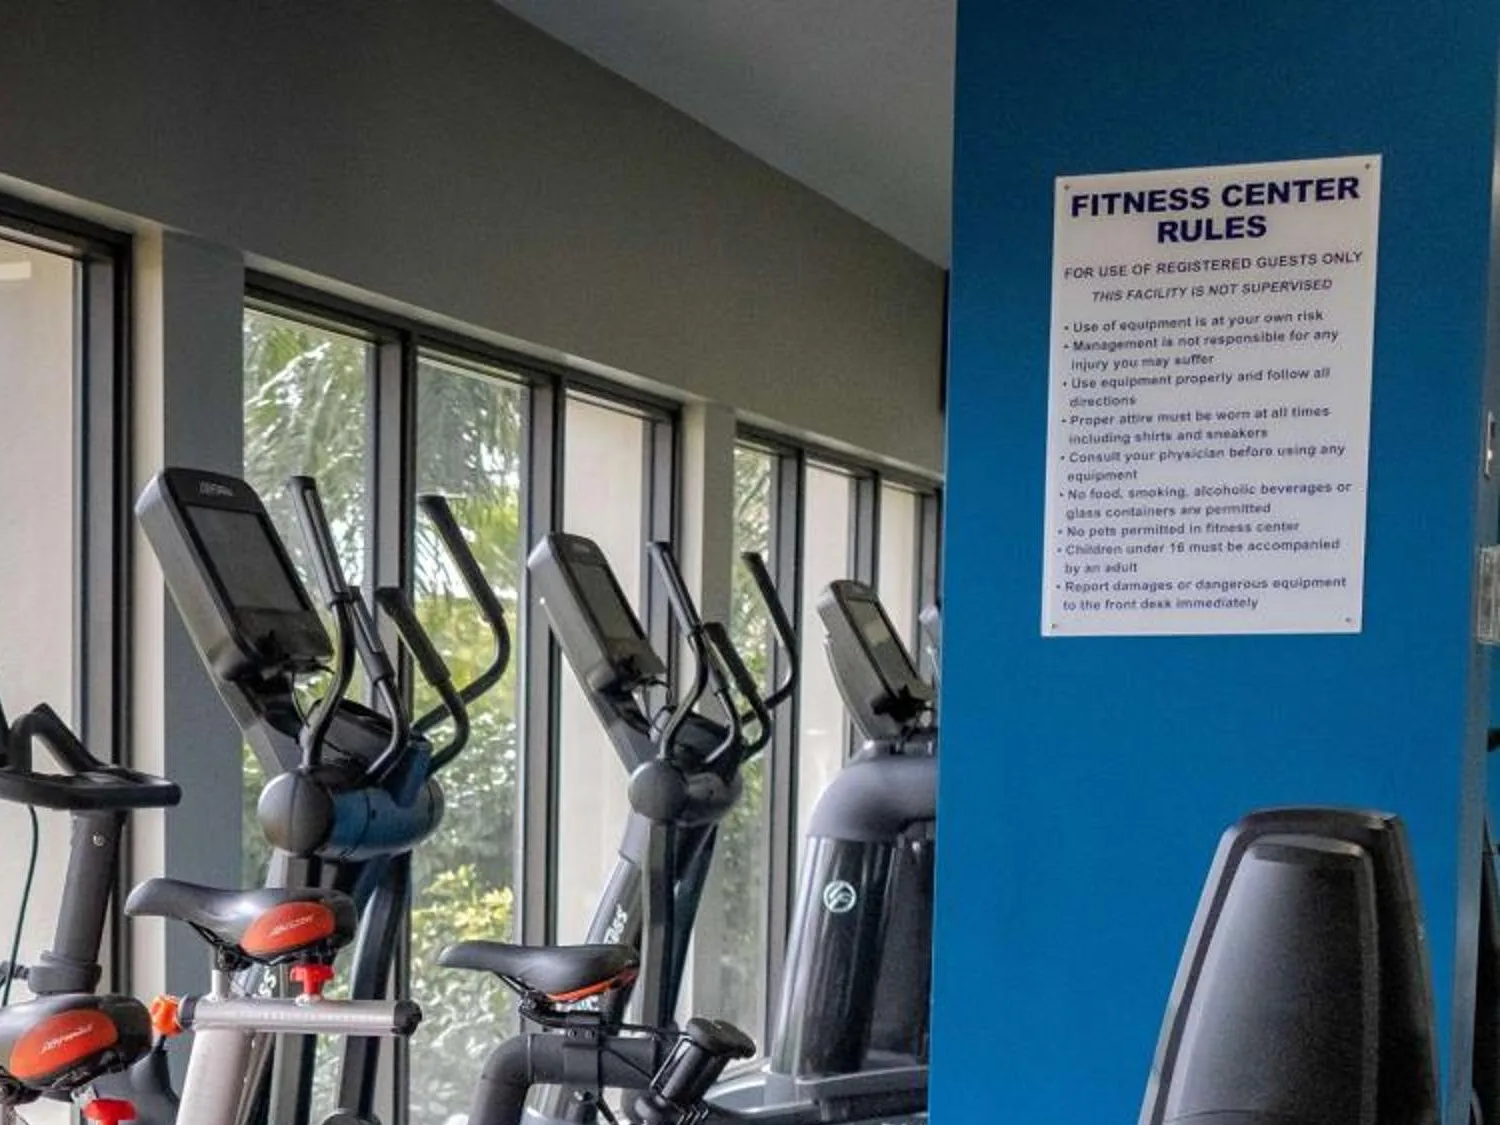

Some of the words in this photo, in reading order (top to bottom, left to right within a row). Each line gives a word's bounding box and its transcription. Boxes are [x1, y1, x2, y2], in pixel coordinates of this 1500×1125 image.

[1071, 187, 1210, 217] FITNESS
[1222, 177, 1359, 208] CENTER
[1157, 215, 1267, 243] RULES
[1064, 267, 1092, 280] FOR
[1099, 265, 1127, 277] USE
[1132, 263, 1150, 275] OF
[1157, 257, 1251, 274] REGISTERED
[1256, 253, 1317, 268] GUESTS
[1322, 251, 1363, 265] ONLY
[1093, 291, 1122, 302] THIS
[1127, 287, 1186, 301] FACILITY
[1191, 287, 1204, 297] IS
[1209, 284, 1239, 296] NOT
[1243, 279, 1332, 294] SUPERVISED
[1073, 321, 1098, 334] Use
[1103, 320, 1116, 332] of
[1120, 317, 1191, 333] equipment
[1196, 315, 1206, 327] is
[1212, 316, 1224, 326] at
[1229, 314, 1259, 327] your
[1263, 312, 1293, 323] own
[1298, 310, 1323, 321] risk
[1073, 337, 1157, 352] Management
[1162, 337, 1173, 348] is
[1178, 335, 1200, 346] not
[1204, 330, 1284, 349] responsible
[1290, 329, 1309, 342] for
[1313, 330, 1338, 343] any
[1071, 358, 1109, 372] injury
[1114, 358, 1138, 370] you
[1142, 357, 1169, 368] may
[1175, 353, 1214, 366] suffer
[1072, 377, 1096, 389] Use
[1101, 375, 1171, 389] equipment
[1176, 372, 1232, 387] properly
[1237, 370, 1263, 382] and
[1267, 369, 1308, 380] follow
[1313, 367, 1330, 378] all
[1069, 394, 1136, 407] directions
[1069, 414, 1113, 428] Proper
[1119, 413, 1153, 425] attire
[1158, 411, 1191, 422] must
[1196, 410, 1212, 421] be
[1217, 409, 1250, 419] worn
[1255, 408, 1267, 419] at
[1272, 407, 1287, 418] all
[1292, 406, 1330, 417] times
[1069, 431, 1130, 446] including
[1135, 430, 1172, 443] shirts
[1177, 429, 1201, 440] and
[1206, 427, 1267, 439] sneakers
[1069, 451, 1120, 463] Consult
[1125, 450, 1155, 463] your
[1160, 446, 1225, 462] physician
[1229, 444, 1272, 458] before
[1277, 444, 1316, 458] using
[1321, 444, 1346, 457] any
[1068, 469, 1138, 483] equipment
[1068, 489, 1085, 500] No
[1194, 482, 1255, 497] alcoholic
[1260, 482, 1332, 497] beverages
[1338, 482, 1352, 493] or
[1066, 506, 1100, 521] glass
[1105, 504, 1175, 518] containers
[1206, 502, 1271, 517] permitted
[1068, 526, 1084, 537] No
[1089, 525, 1116, 539] pets
[1122, 523, 1184, 537] permitted
[1190, 523, 1200, 534] in
[1206, 522, 1251, 534] fitness
[1256, 520, 1300, 532] center
[1065, 543, 1122, 556] Children
[1126, 542, 1164, 554] under
[1189, 540, 1222, 552] must
[1226, 539, 1242, 551] be
[1247, 537, 1340, 553] accompanied
[1065, 562, 1080, 576] by
[1105, 560, 1137, 573] adult
[1065, 580, 1108, 594] Report
[1113, 579, 1172, 593] damages
[1177, 580, 1191, 589] or
[1196, 577, 1268, 591] dangerous
[1272, 576, 1346, 591] equipment
[1064, 599, 1076, 610] to
[1080, 598, 1100, 610] the
[1105, 597, 1136, 609] front
[1140, 596, 1171, 609] desk
[1176, 595, 1258, 610] immediately
